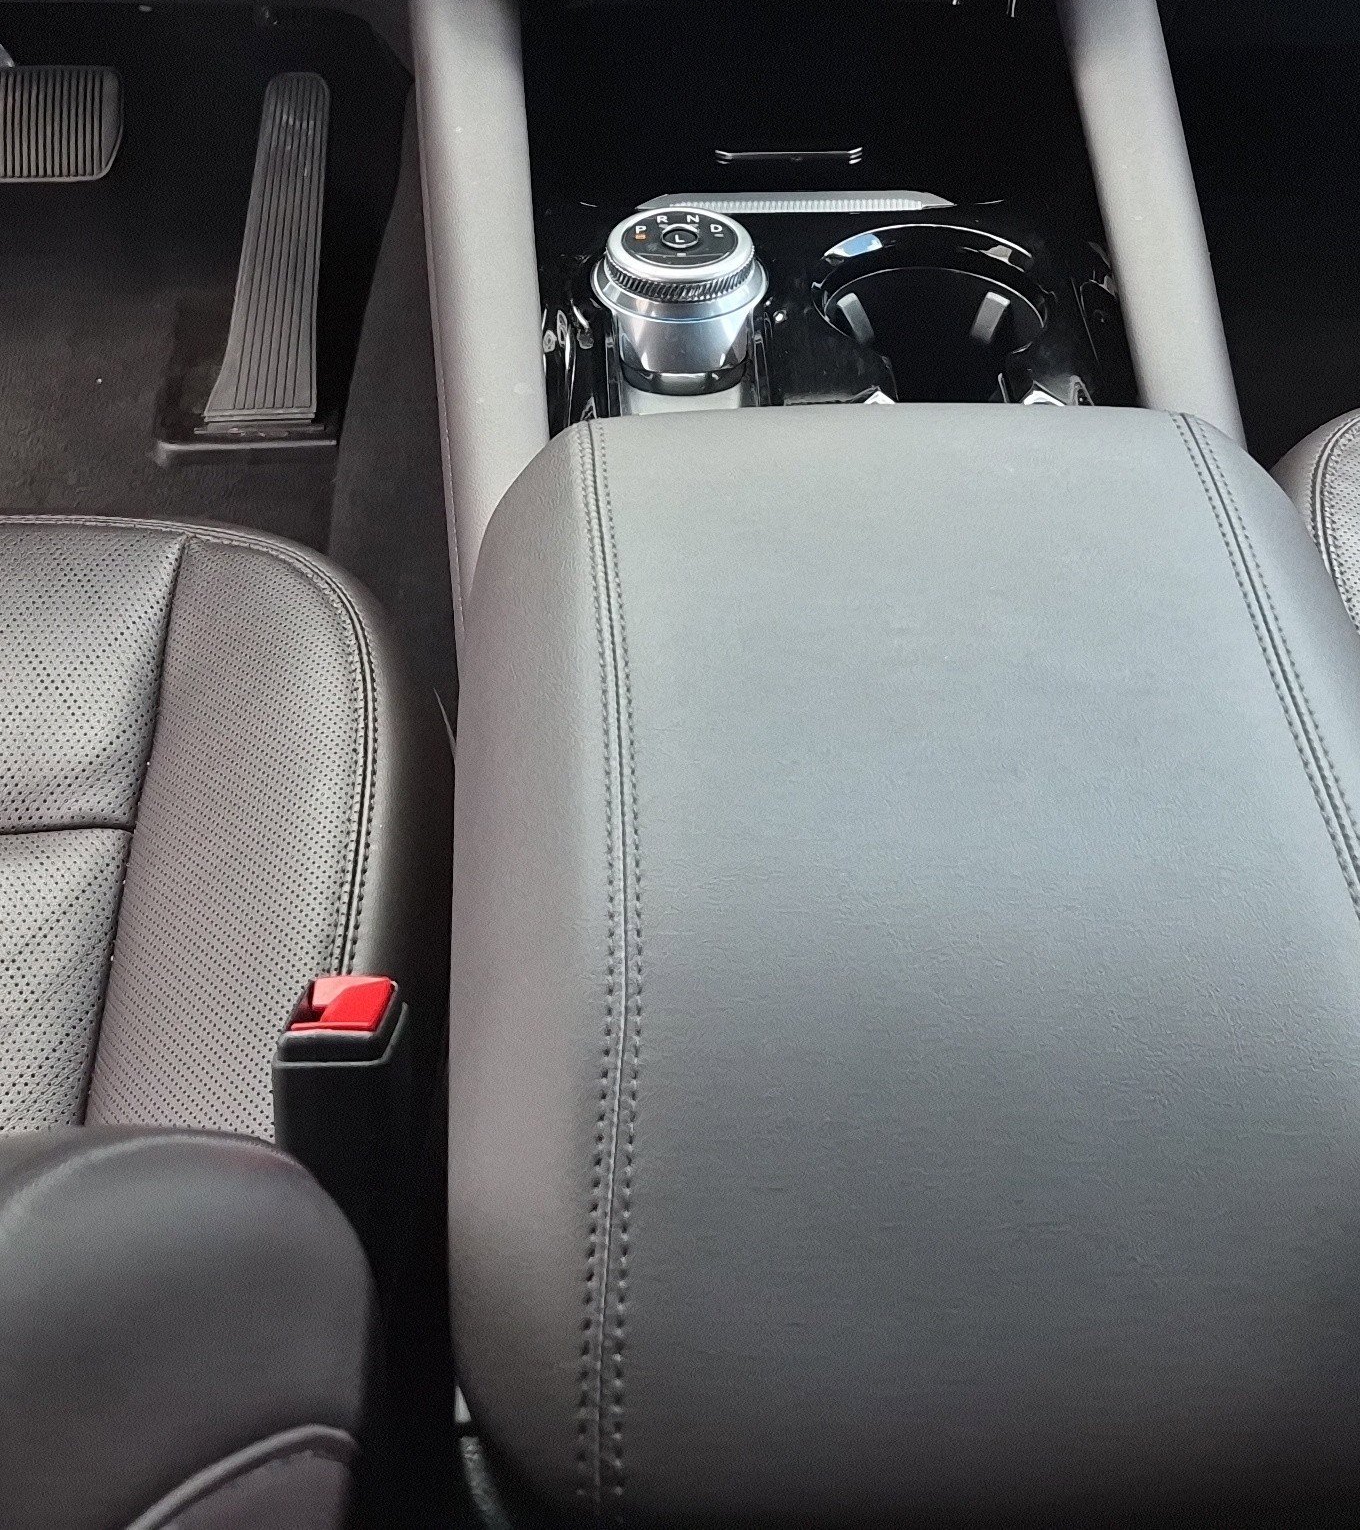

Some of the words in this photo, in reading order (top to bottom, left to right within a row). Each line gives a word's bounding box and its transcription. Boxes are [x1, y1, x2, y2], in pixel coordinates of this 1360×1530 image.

[656, 215, 669, 224] R
[686, 214, 700, 223] N
[635, 225, 647, 234] P
[709, 223, 723, 233] D
[674, 234, 685, 243] L
